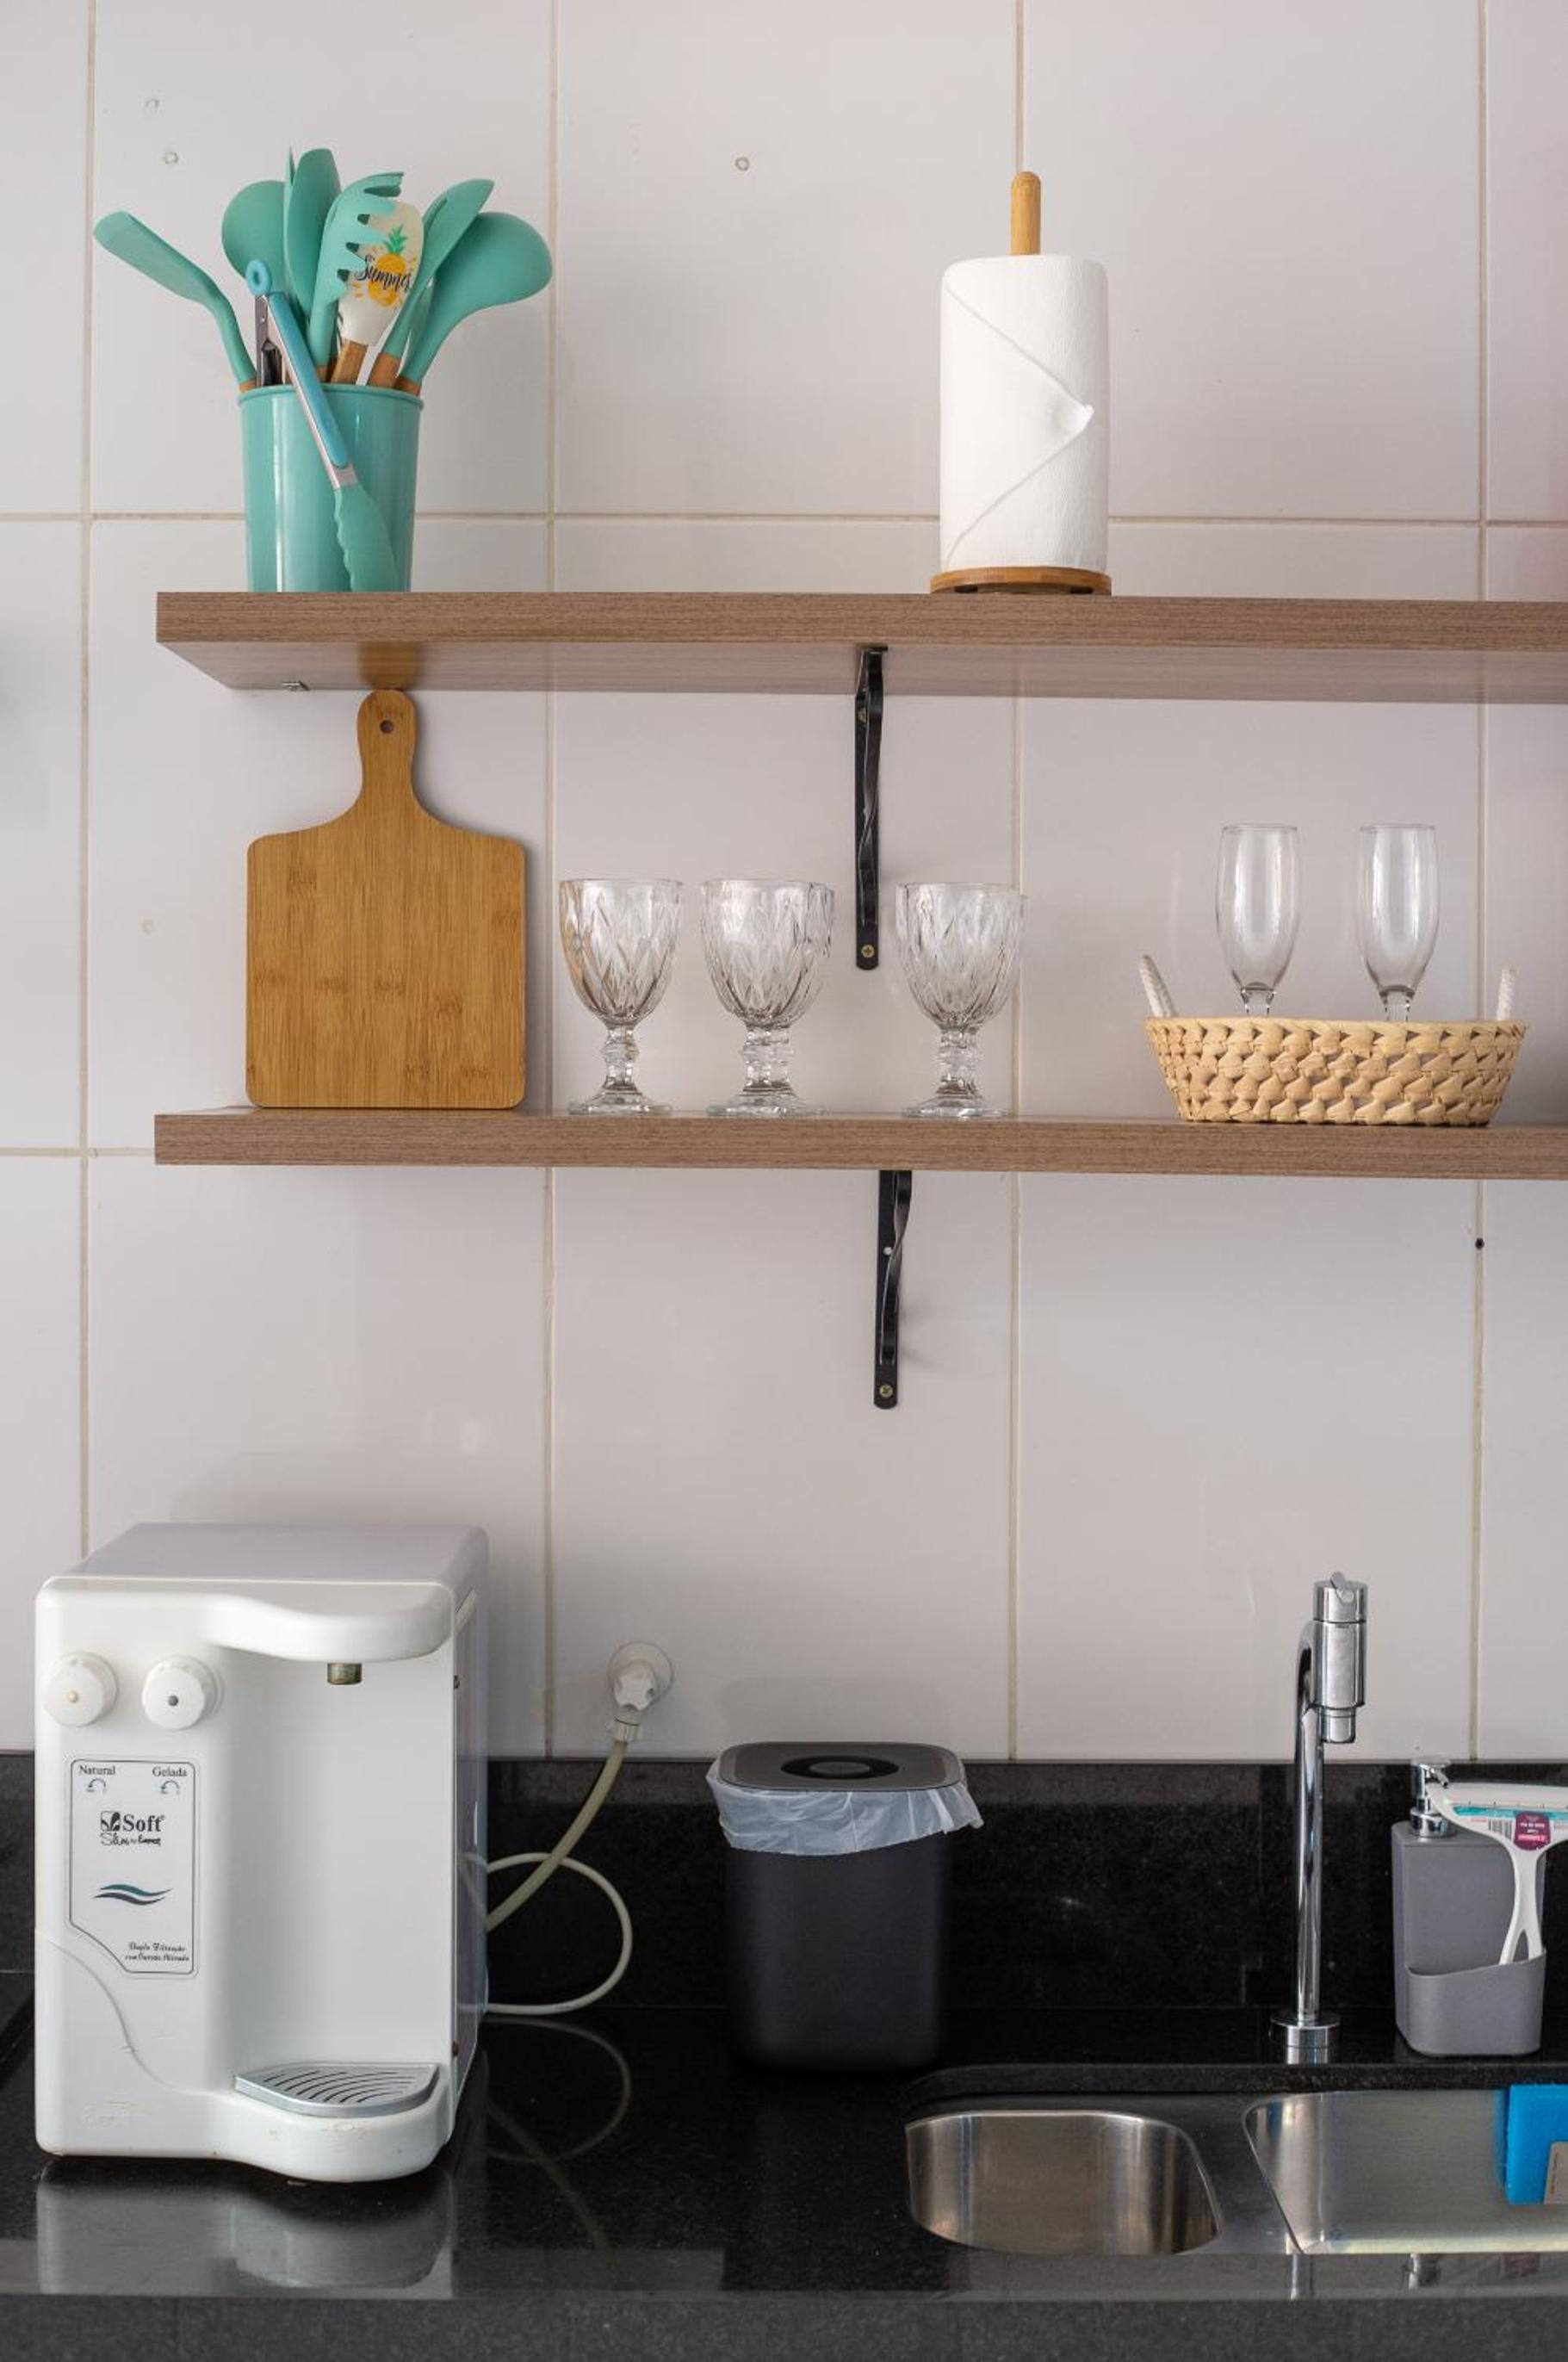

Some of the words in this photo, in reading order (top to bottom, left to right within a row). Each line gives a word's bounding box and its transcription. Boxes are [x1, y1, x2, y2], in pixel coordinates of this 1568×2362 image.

[79, 1764, 116, 1776] Natural
[152, 1766, 188, 1777] Gelada
[122, 1813, 162, 1832] Soft
